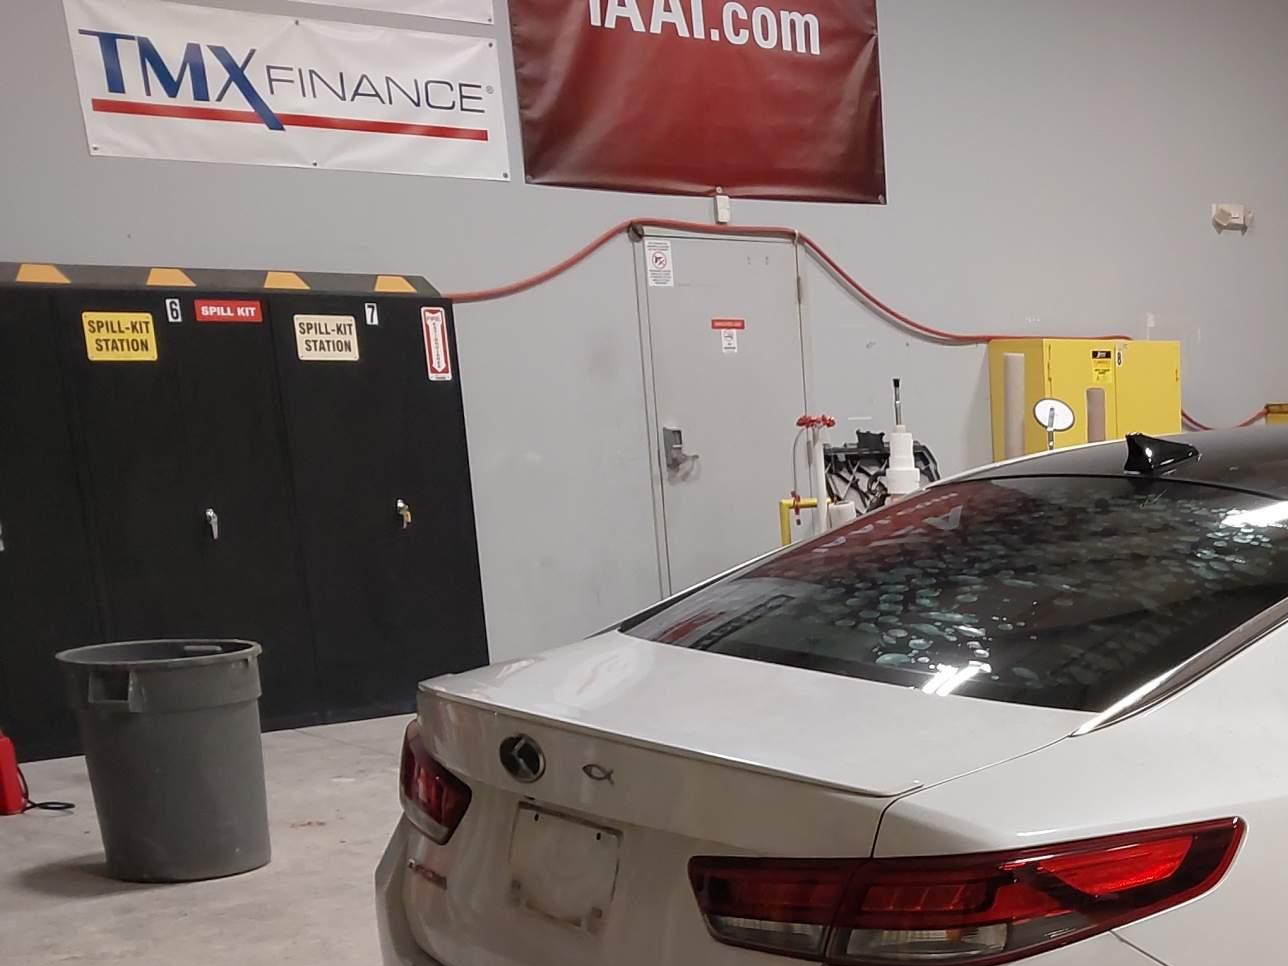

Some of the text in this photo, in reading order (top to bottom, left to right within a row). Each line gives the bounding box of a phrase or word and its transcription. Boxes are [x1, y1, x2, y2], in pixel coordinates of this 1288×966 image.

[78, 29, 285, 131] TMX
[169, 300, 180, 320] 6
[201, 305, 257, 317] SPILL KIT
[366, 304, 376, 324] 7
[87, 319, 151, 335] SPILL-KIT
[298, 321, 353, 336] SPILL-KIT
[95, 338, 149, 353] STATION
[304, 339, 352, 353] STATION
